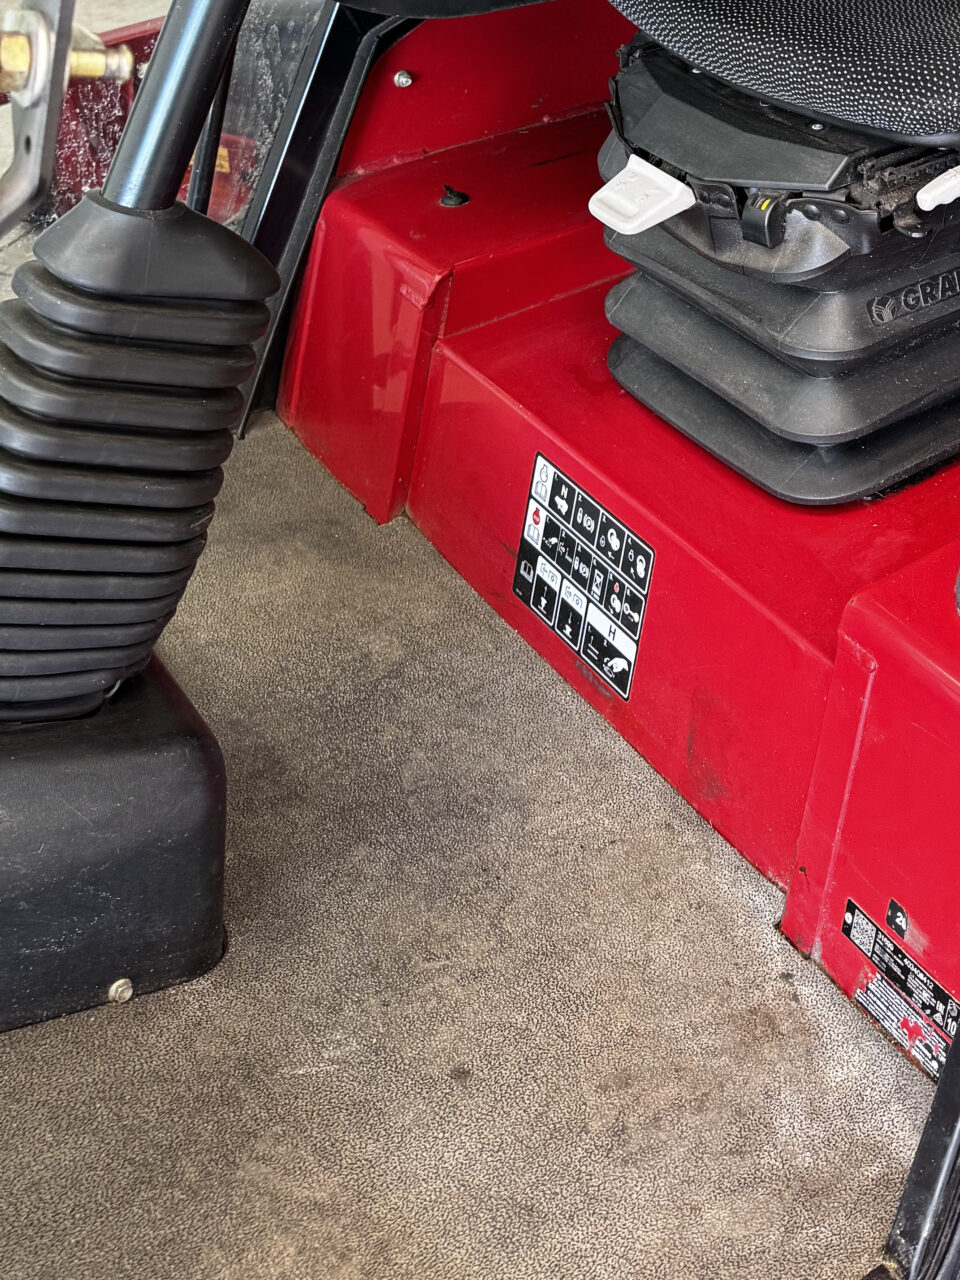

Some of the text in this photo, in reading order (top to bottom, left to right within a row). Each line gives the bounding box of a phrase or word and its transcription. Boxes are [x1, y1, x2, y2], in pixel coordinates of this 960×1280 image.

[560, 484, 568, 499] N
[608, 624, 617, 641] H
[947, 1017, 957, 1036] 10
